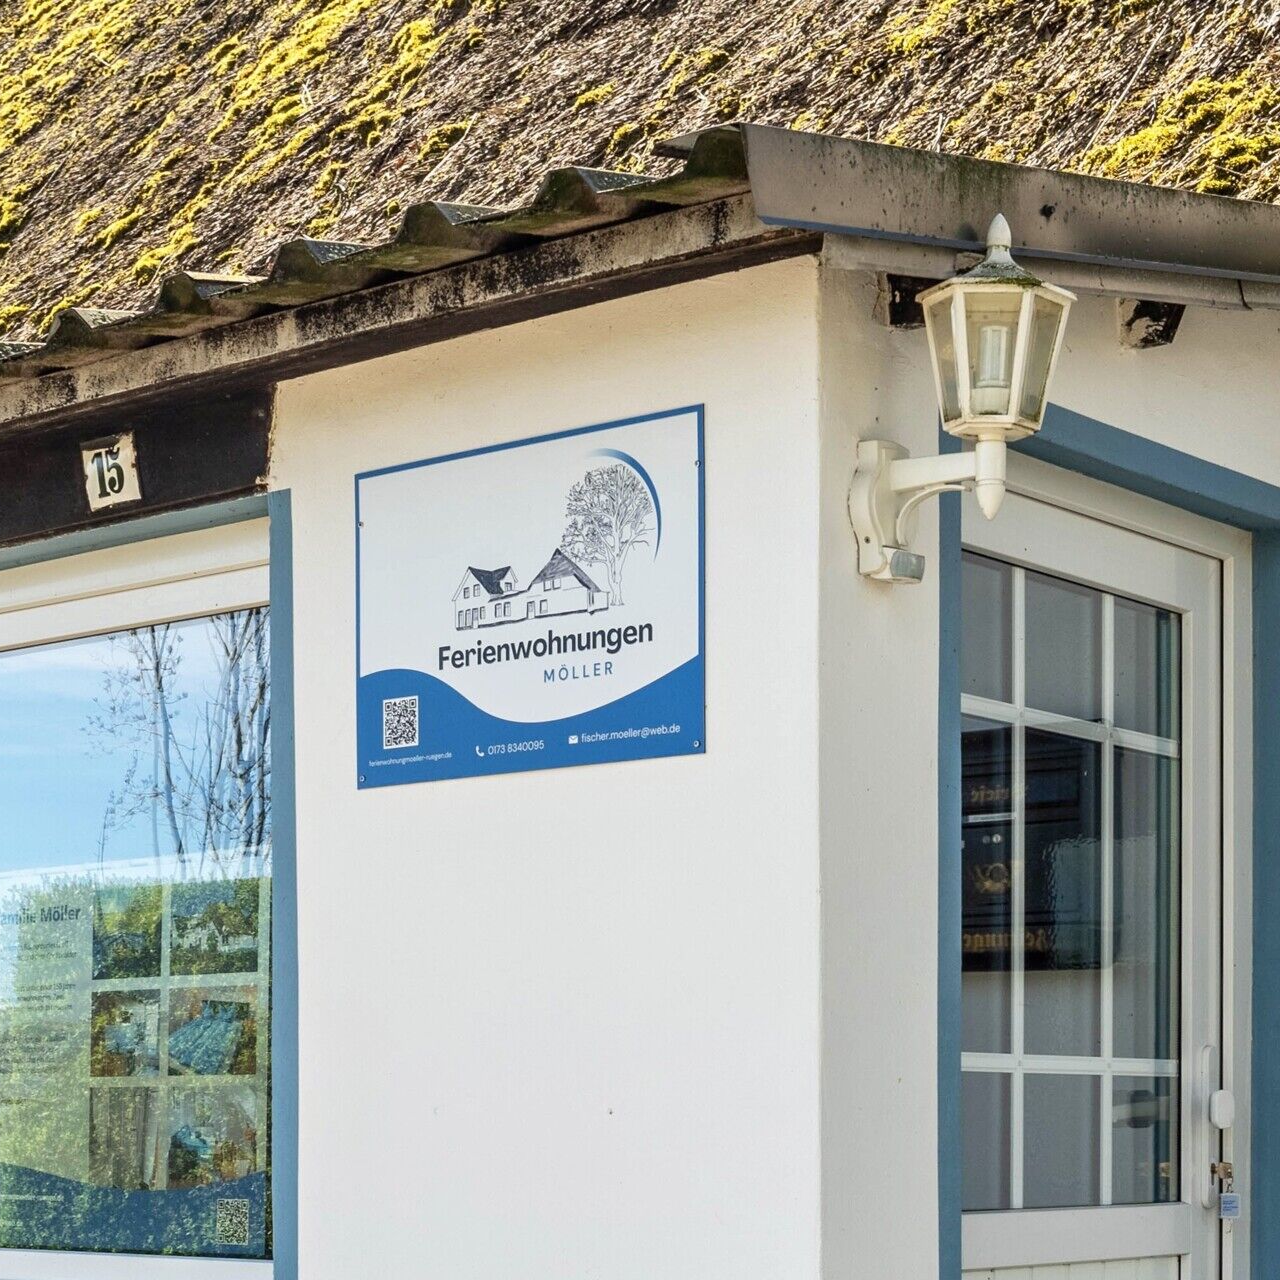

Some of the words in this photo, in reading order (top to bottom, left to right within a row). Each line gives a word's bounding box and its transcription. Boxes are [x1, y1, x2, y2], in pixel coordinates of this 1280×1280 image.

[91, 447, 124, 498] 15
[438, 623, 653, 670] Ferienwohnungen
[543, 661, 614, 683] MÖLLER
[581, 723, 681, 743] fischer.moeller@web.de
[487, 743, 506, 755] 0173
[507, 740, 545, 753] 8340095
[40, 904, 82, 923] Möller
